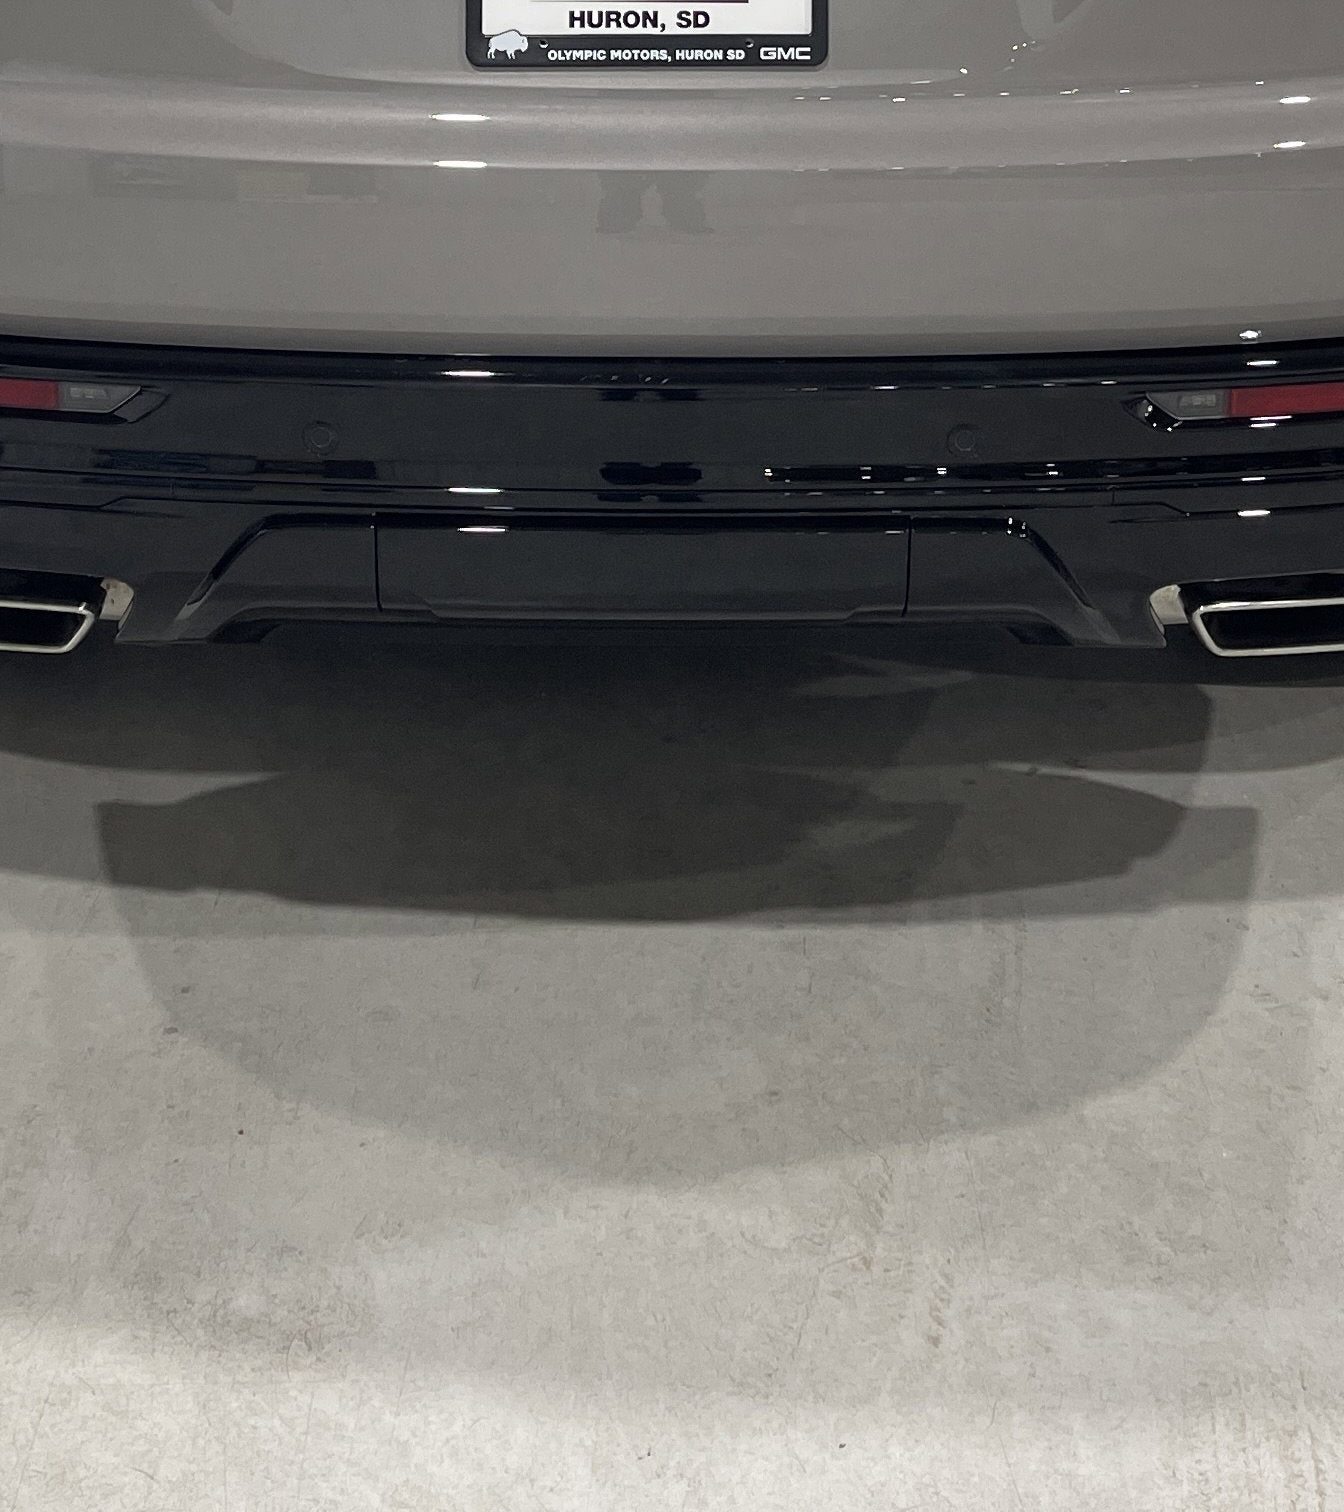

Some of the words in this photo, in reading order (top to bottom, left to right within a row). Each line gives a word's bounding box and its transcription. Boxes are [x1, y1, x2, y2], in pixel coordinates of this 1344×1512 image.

[569, 10, 666, 33] HURON,
[676, 10, 711, 29] SD
[547, 48, 606, 61] OLYMPIC
[610, 48, 672, 63] MOTORS,
[676, 48, 723, 61] HURON
[726, 48, 746, 61] SD
[759, 46, 812, 61] GMC
